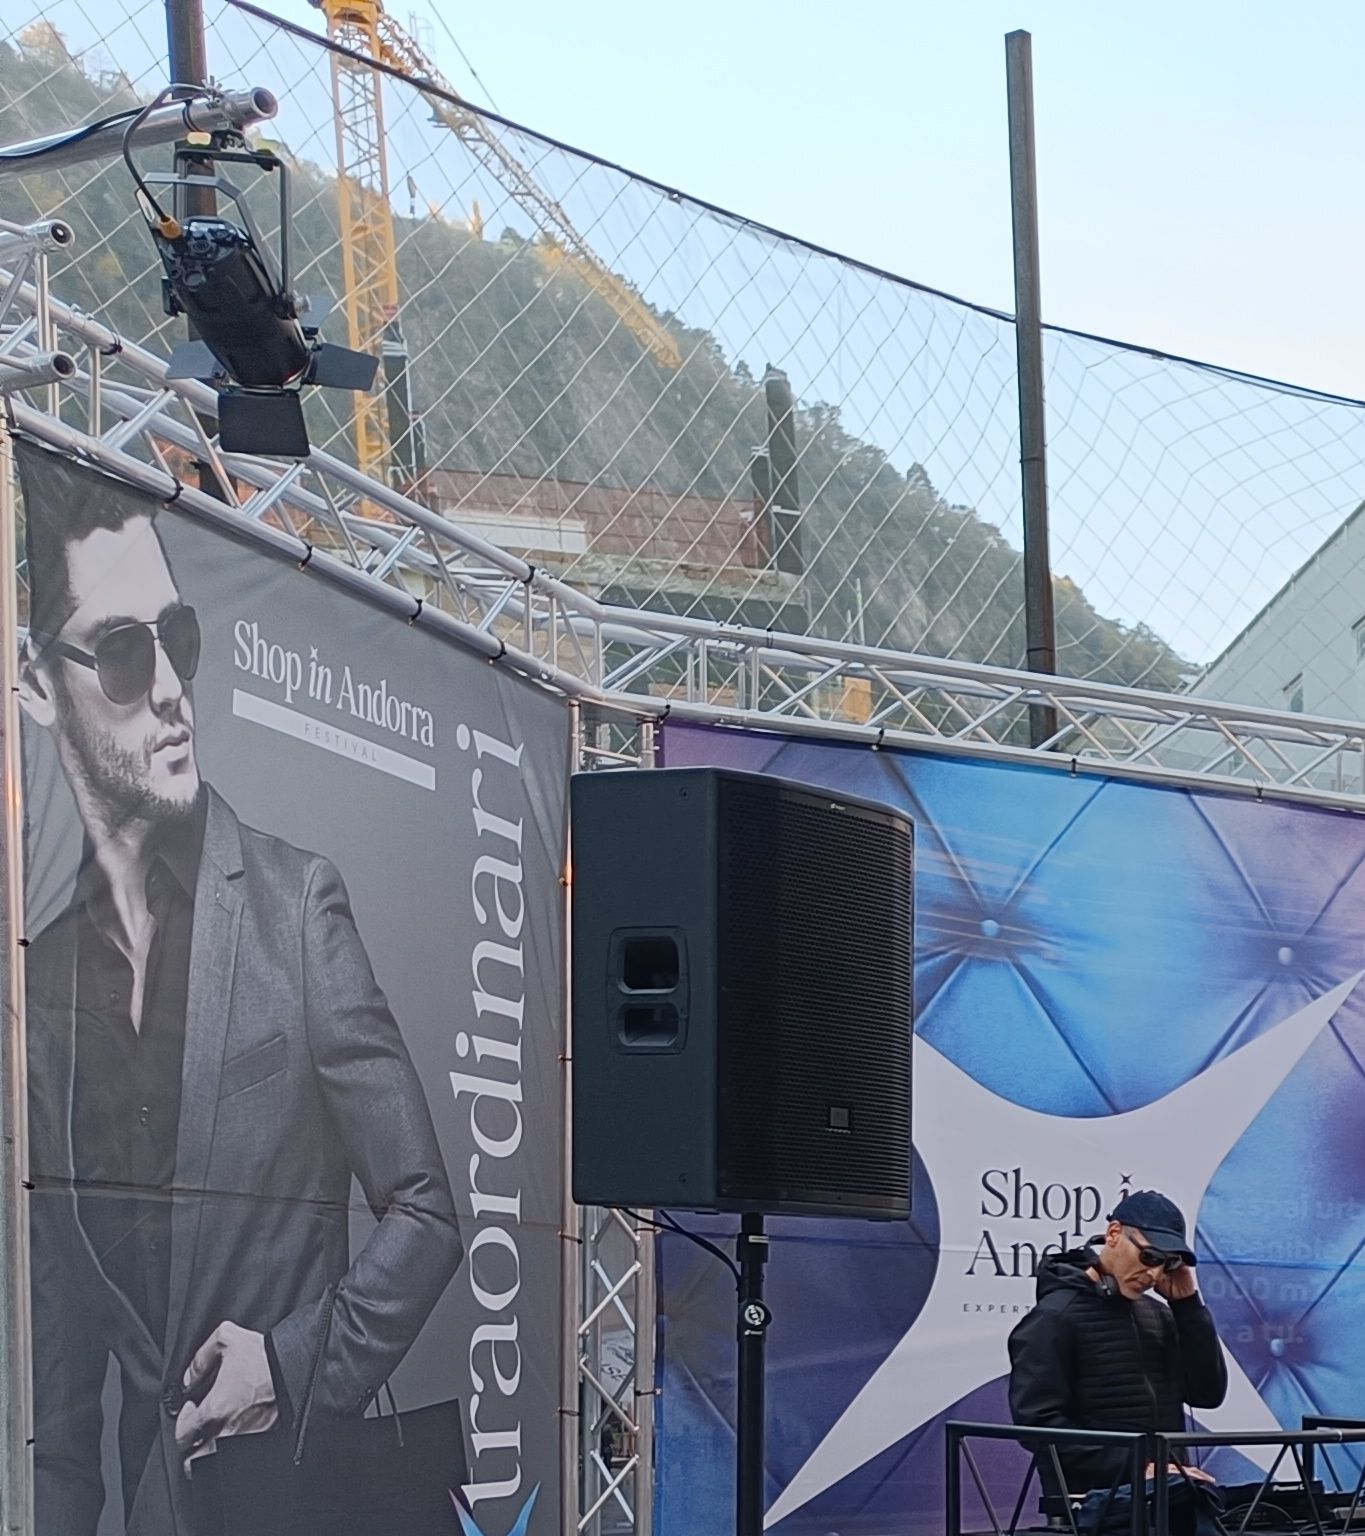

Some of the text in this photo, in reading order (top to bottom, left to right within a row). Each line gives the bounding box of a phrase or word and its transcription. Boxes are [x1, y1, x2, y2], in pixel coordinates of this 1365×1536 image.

[233, 620, 435, 747] Shop in Andorra
[304, 722, 378, 762] FESTIVAL
[981, 1167, 1101, 1236] Shop
